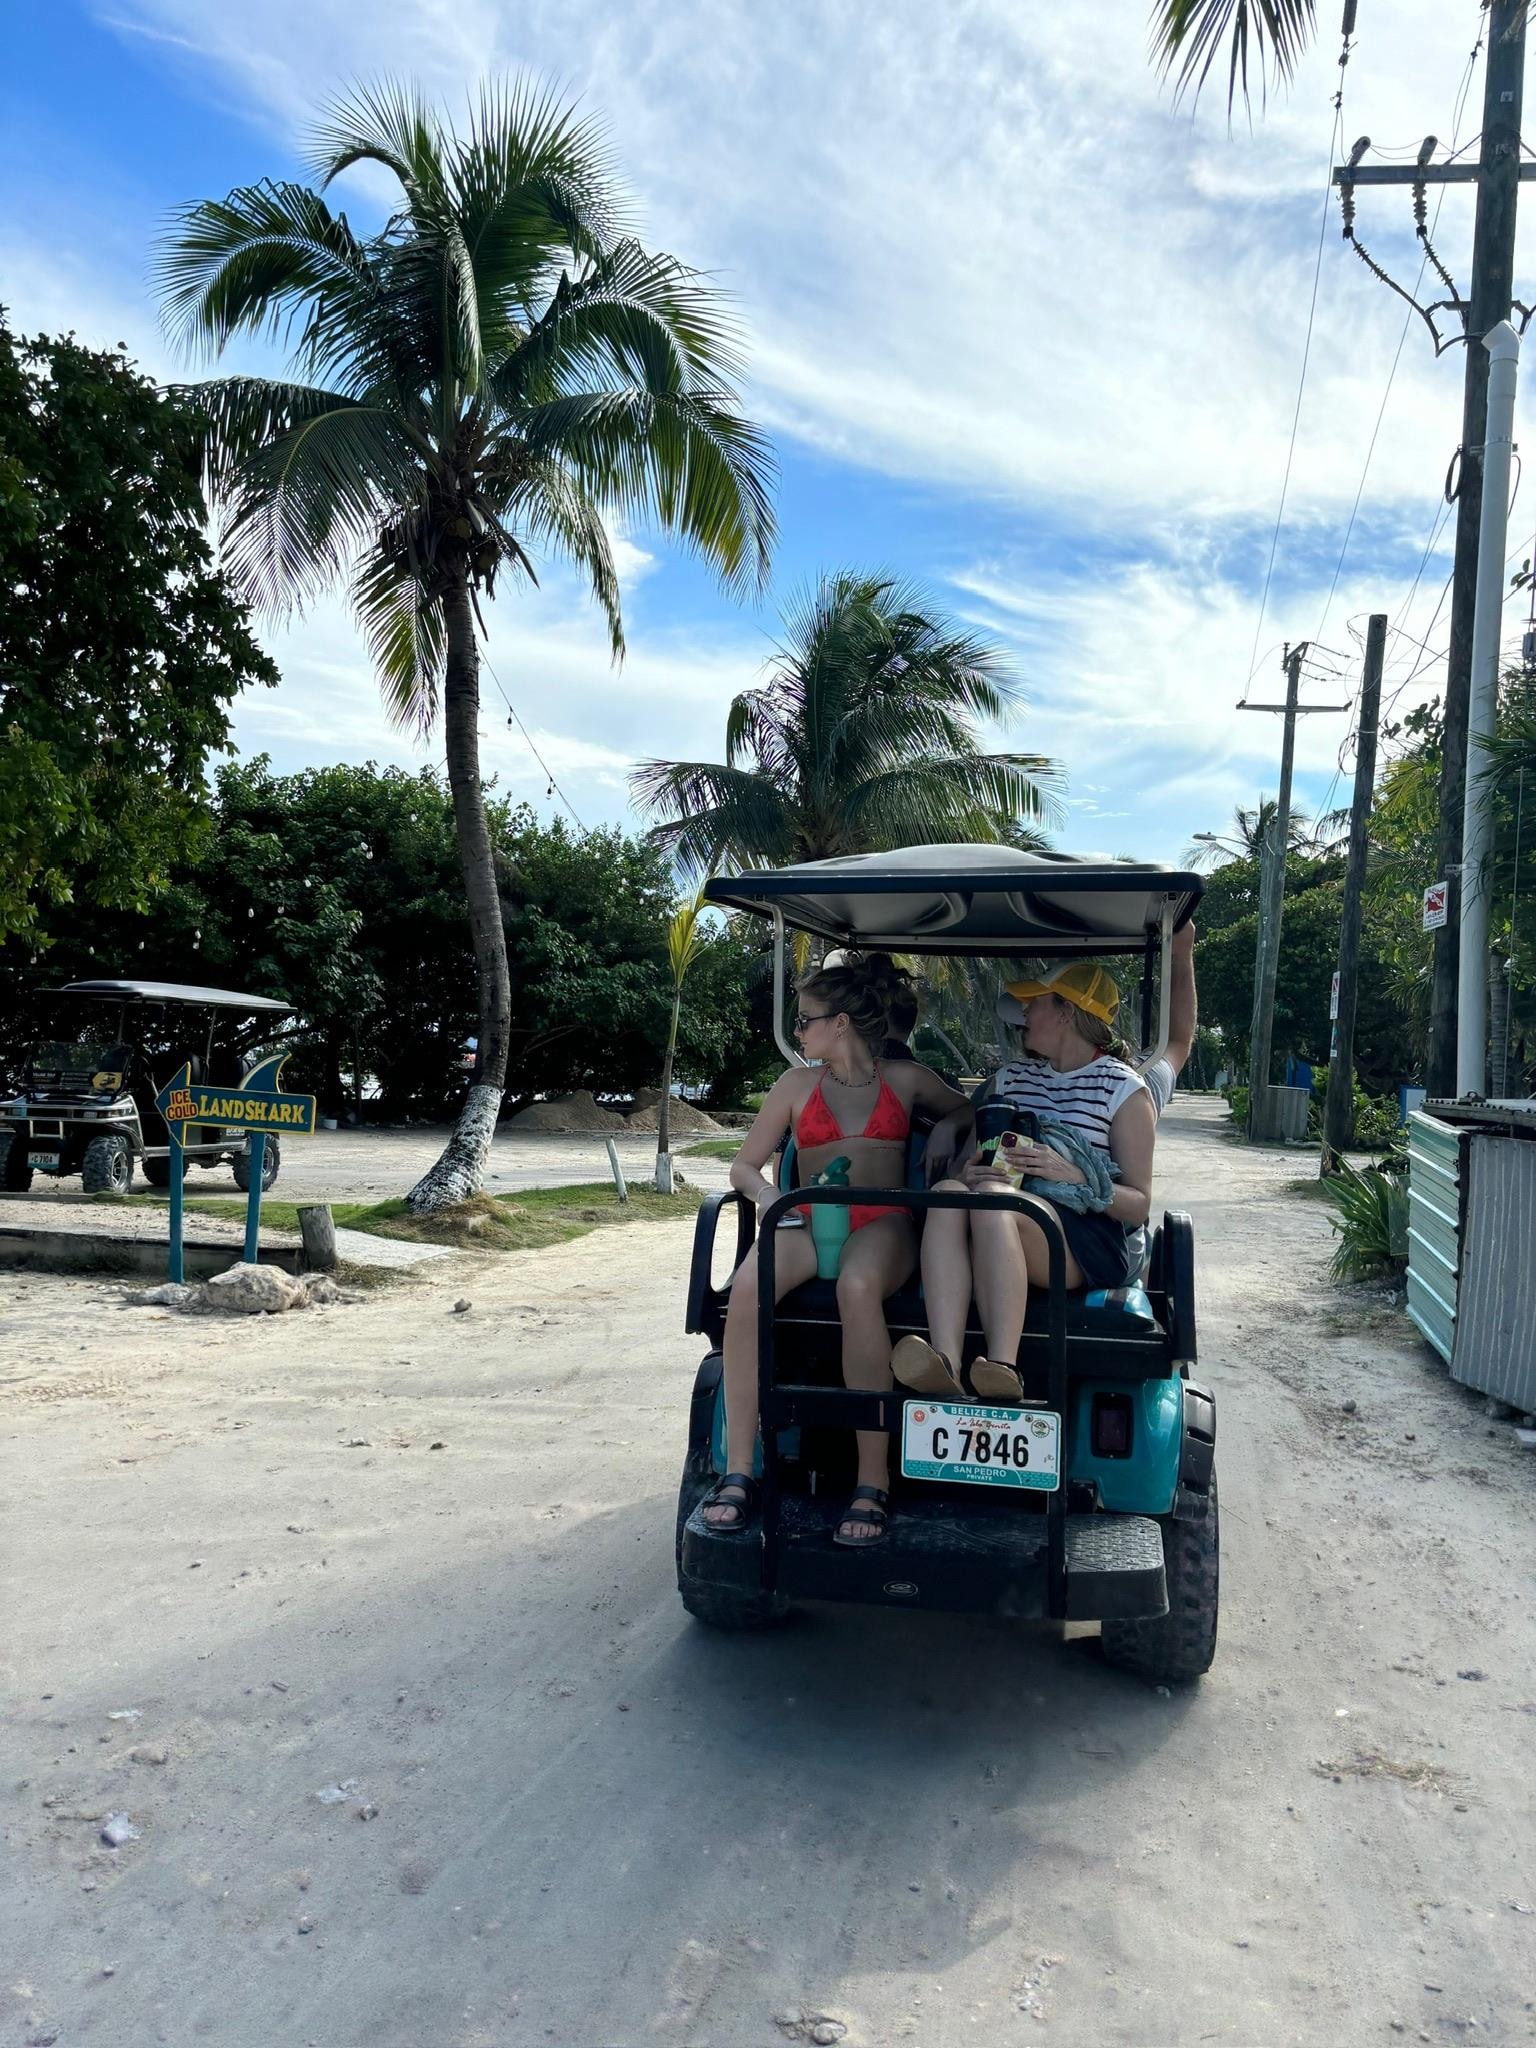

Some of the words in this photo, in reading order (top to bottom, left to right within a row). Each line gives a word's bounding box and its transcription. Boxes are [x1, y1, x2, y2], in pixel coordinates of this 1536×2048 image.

[171, 1089, 190, 1104] ICE
[167, 1104, 198, 1120] COLD
[199, 1095, 305, 1124] LANDSHARK
[951, 1406, 987, 1417] BELIZE
[991, 1410, 1012, 1420] C.A.
[955, 1417, 967, 1426] La
[932, 1428, 949, 1460] C
[958, 1429, 1029, 1468] 7846
[953, 1465, 972, 1474] SAN
[974, 1467, 1007, 1478] PEDRO
